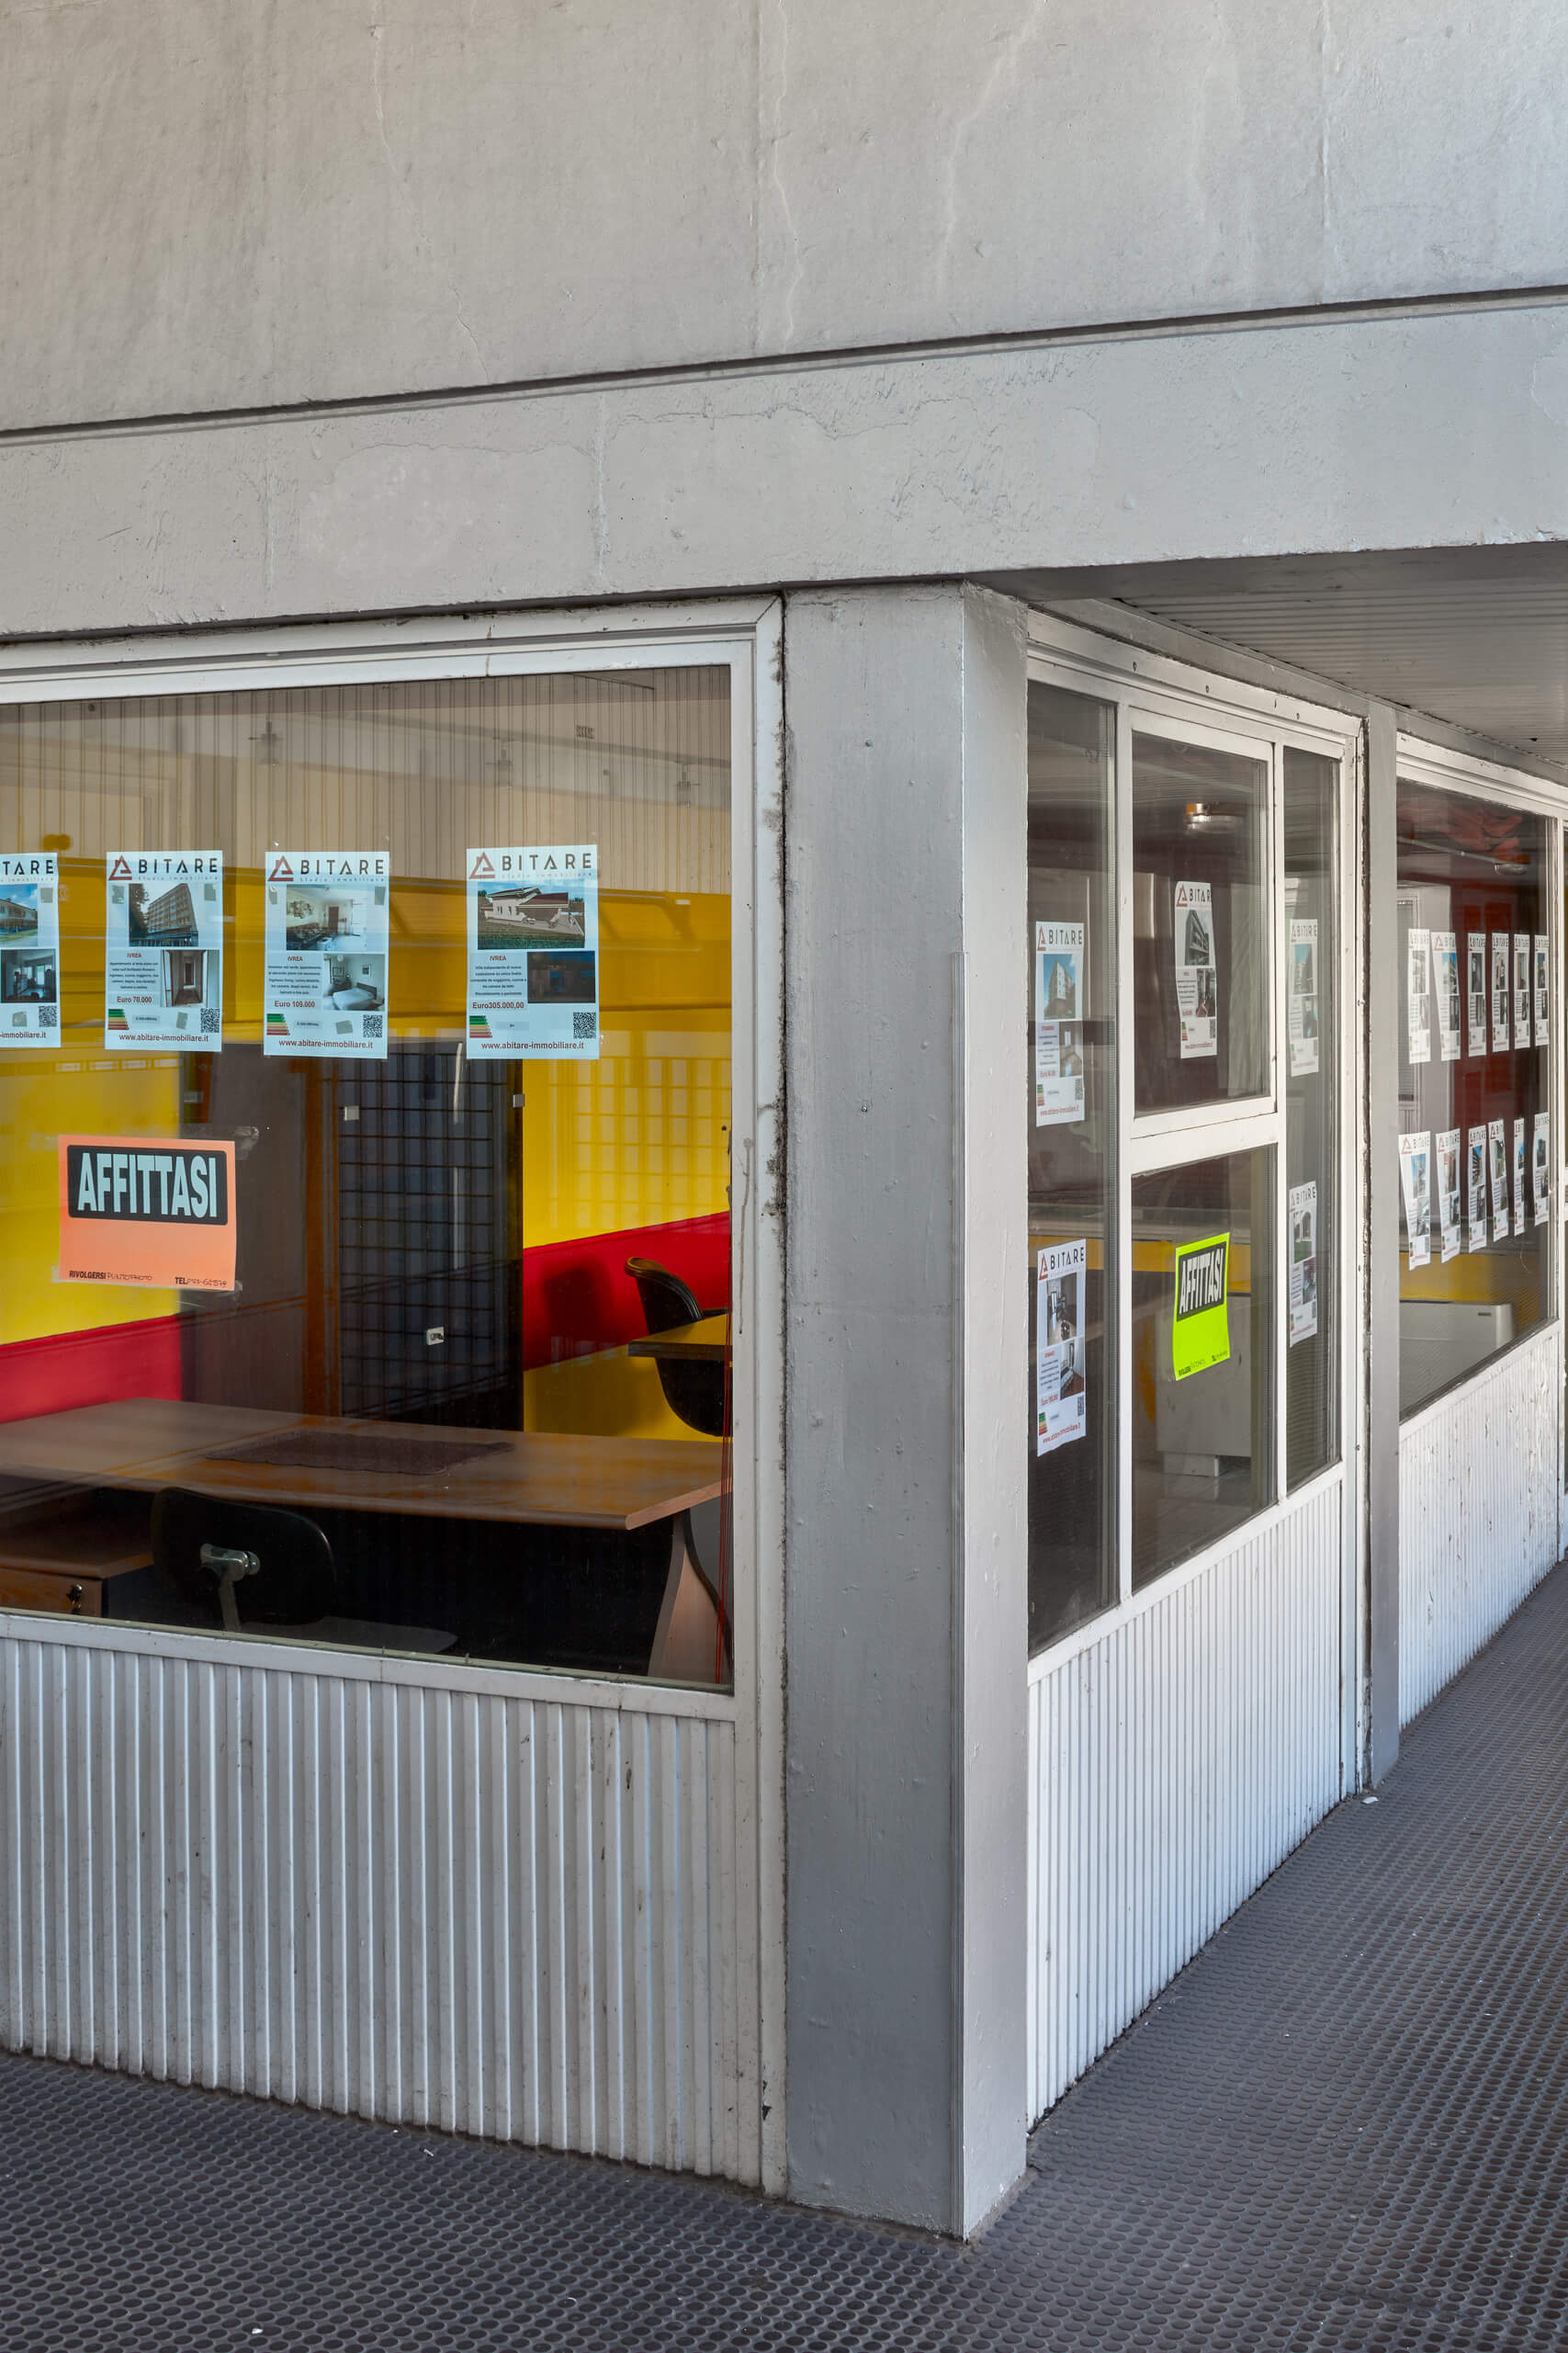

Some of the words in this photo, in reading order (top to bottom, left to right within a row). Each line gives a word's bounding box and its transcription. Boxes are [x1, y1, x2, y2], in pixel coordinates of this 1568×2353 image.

[2, 860, 53, 876] TARE
[1176, 885, 1211, 908] ABITAR
[1036, 925, 1082, 951] ABITARE
[274, 1000, 290, 1008] Euro
[118, 1034, 209, 1042] www.abitare-immobiliare.it
[278, 1039, 373, 1048] www.abitare-immobiliare.it
[481, 1041, 584, 1049] www.abitare-immobiliare.it
[77, 1152, 218, 1218] AFFITTASI
[1039, 1246, 1084, 1280] ABITARE
[69, 1270, 107, 1280] RIVOLGERSI
[1179, 1249, 1224, 1314] AFFITTASI
